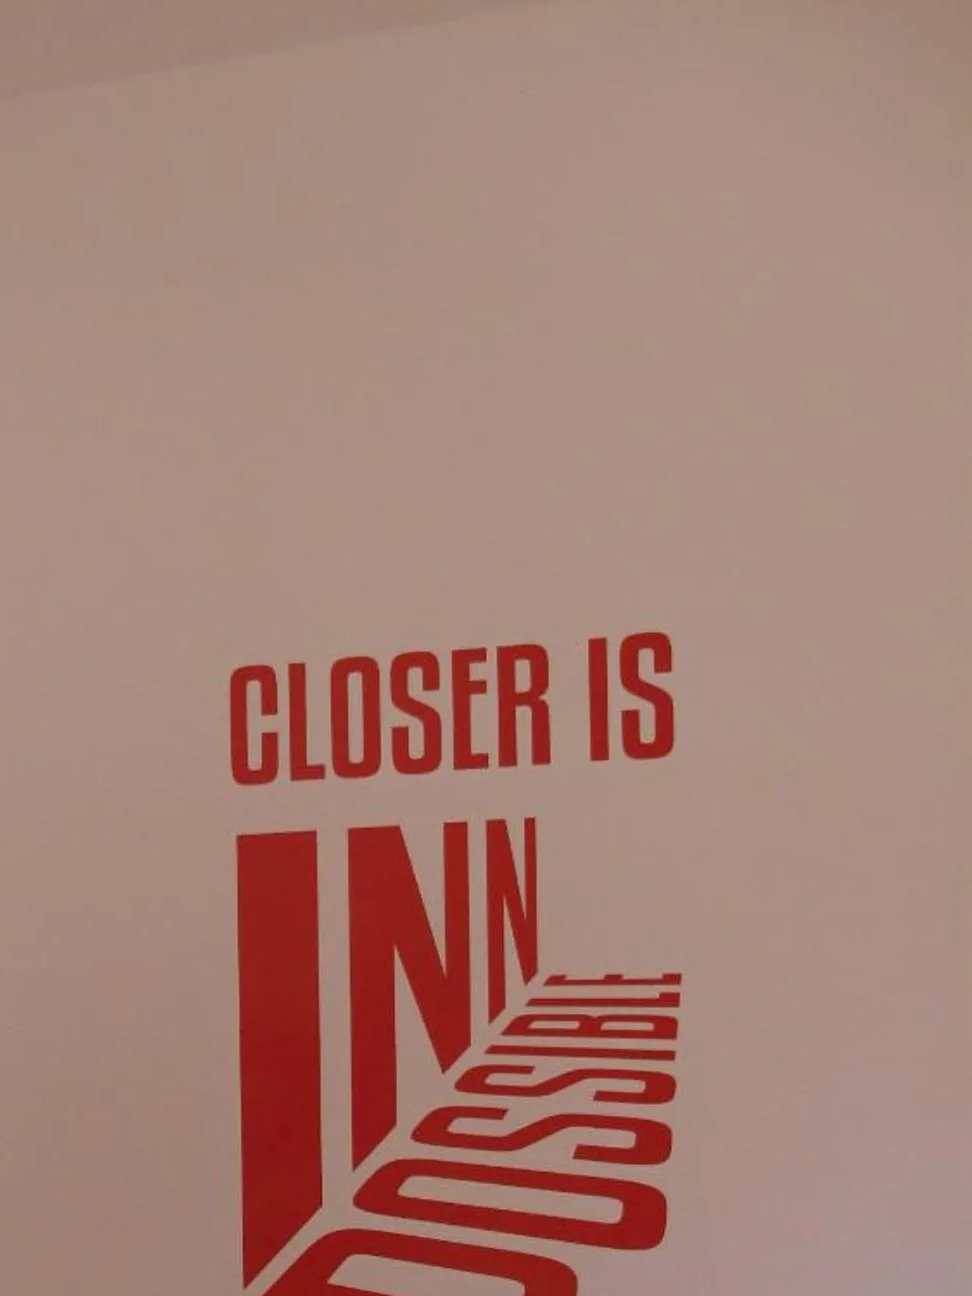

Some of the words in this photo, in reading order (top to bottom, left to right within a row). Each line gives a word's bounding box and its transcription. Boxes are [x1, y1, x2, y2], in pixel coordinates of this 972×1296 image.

[229, 644, 551, 785] CLOSER
[587, 632, 675, 761] IS
[236, 816, 539, 1290] INN
